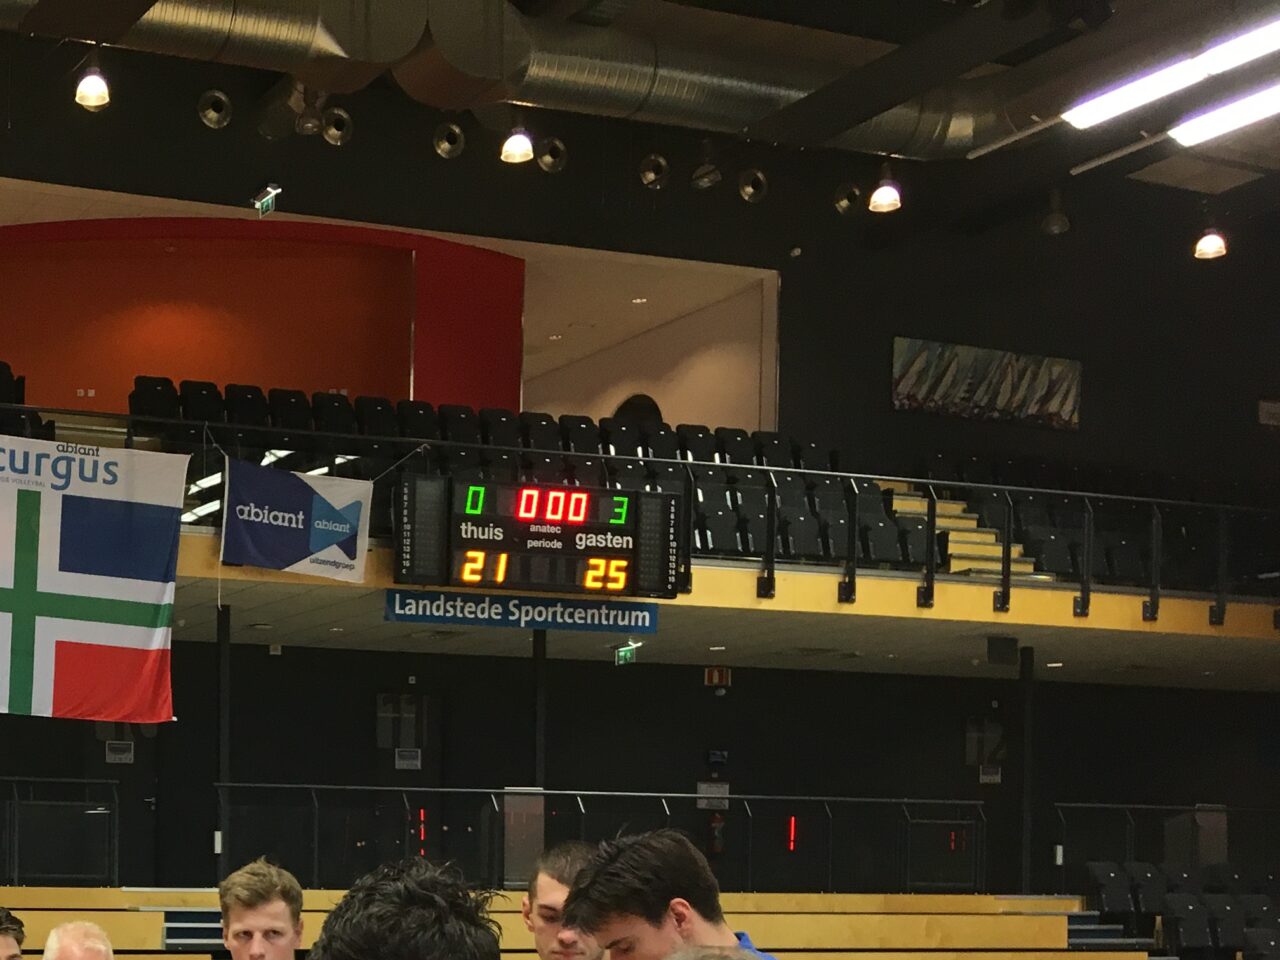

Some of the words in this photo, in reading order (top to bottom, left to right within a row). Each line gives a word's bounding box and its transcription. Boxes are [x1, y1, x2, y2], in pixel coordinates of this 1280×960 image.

[56, 442, 100, 457] abiant
[236, 503, 305, 529] abiant
[465, 486, 485, 515] 0
[609, 497, 628, 524] 3
[314, 520, 350, 533] abiant
[460, 522, 504, 540] thuis
[529, 524, 562, 534] anatec
[575, 531, 633, 549] gasten
[527, 538, 563, 549] periode
[309, 557, 355, 572] uitzendgroep
[462, 551, 508, 583] 21
[585, 558, 628, 589] 25
[394, 594, 503, 619] Landstede
[508, 600, 650, 627] Sportcentrum
